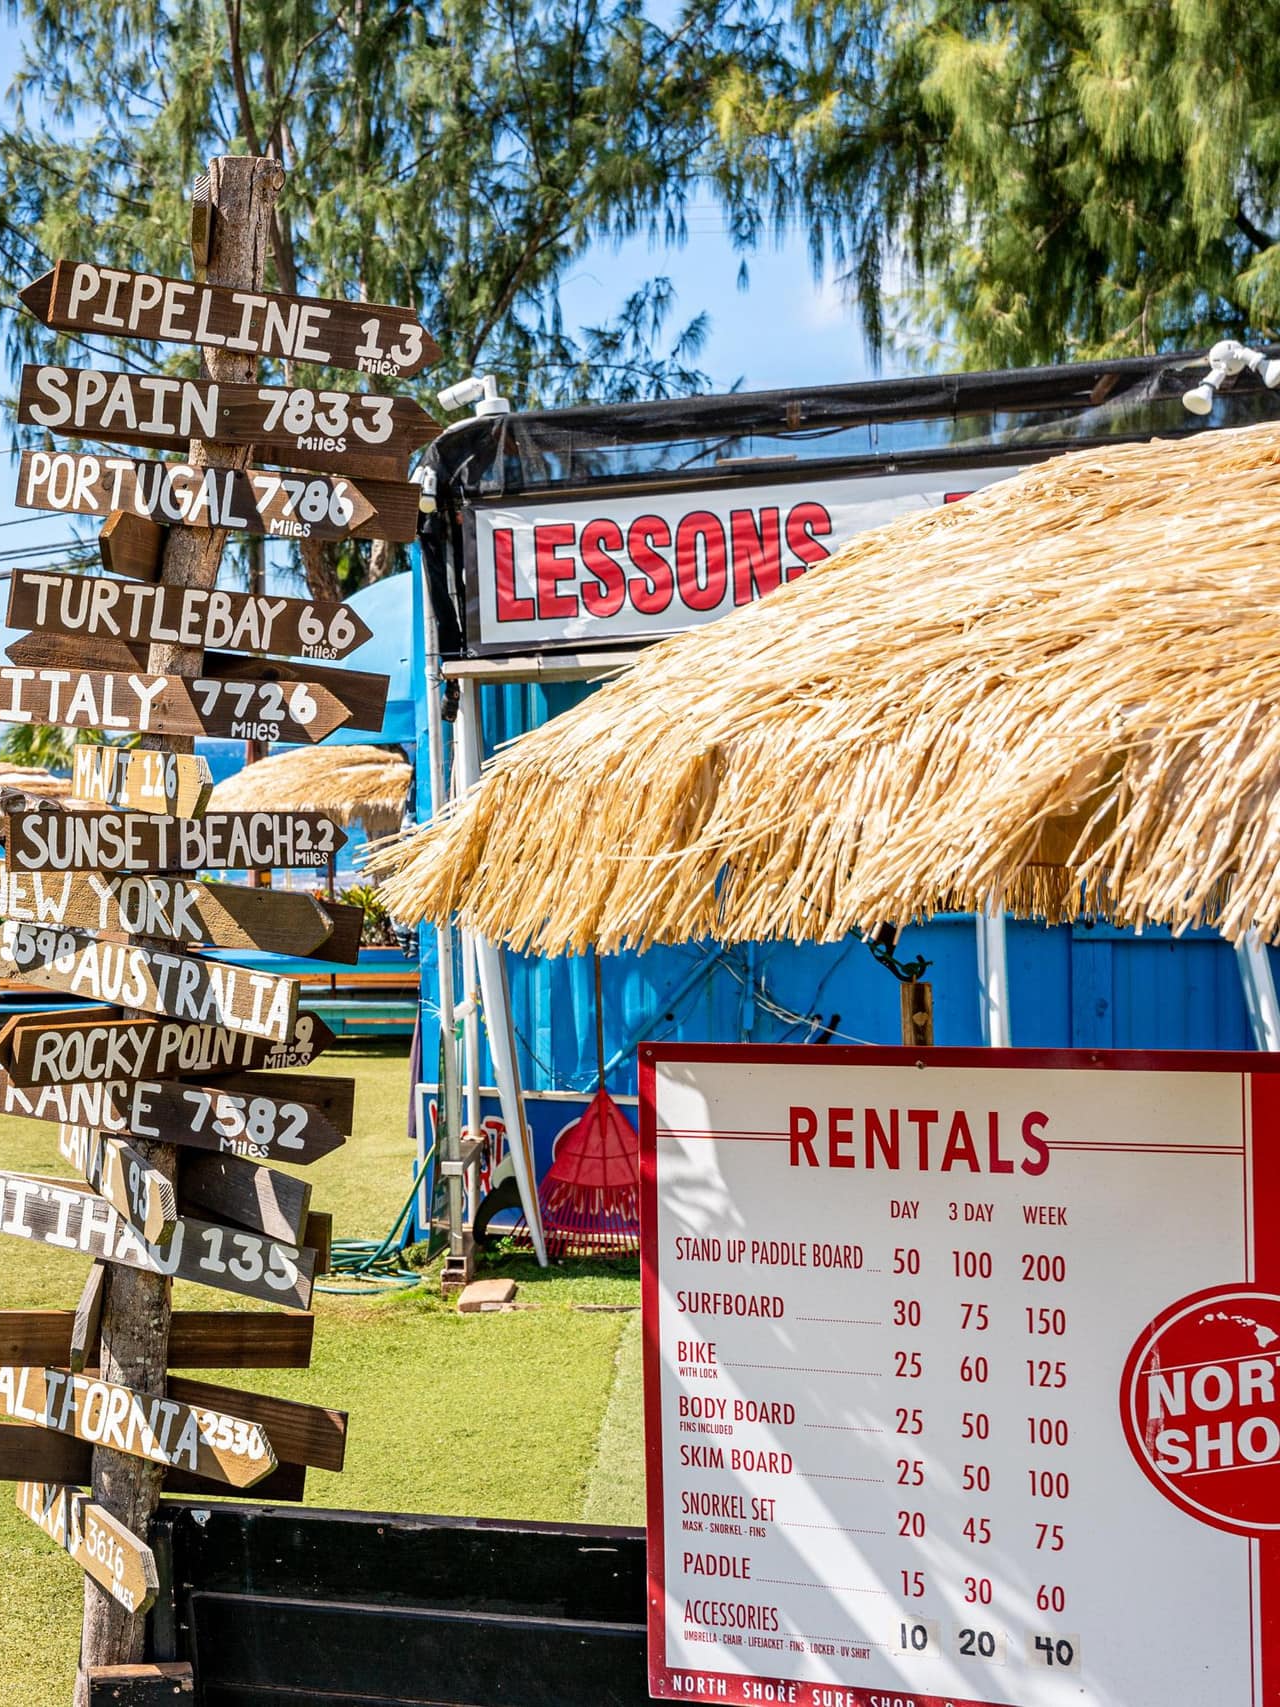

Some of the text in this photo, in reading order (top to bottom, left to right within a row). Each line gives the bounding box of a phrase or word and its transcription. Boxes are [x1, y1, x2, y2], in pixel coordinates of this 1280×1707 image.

[67, 262, 331, 363] PIPELINE
[357, 357, 400, 377] Miles
[28, 366, 394, 444] SPAIN 7833
[296, 435, 346, 453] Miles
[26, 451, 354, 529] PORTUGAL 7786
[269, 517, 311, 538] Miles
[493, 501, 832, 624] LESSONS
[301, 643, 337, 661] Miles
[192, 679, 318, 726] 7726
[231, 721, 280, 742] Miles
[75, 748, 177, 804] MAUI 126
[16, 814, 174, 870] SUNSET
[179, 812, 295, 870] BEACH
[295, 851, 329, 866] Miles
[88, 875, 203, 941] YORK
[70, 940, 293, 1044] AUSTRALIA
[31, 1024, 154, 1082] ROCKY
[183, 1090, 310, 1150] 7582
[790, 1106, 1050, 1176] RENTALS
[219, 1137, 270, 1159] Miles
[890, 1200, 919, 1220] DAY
[948, 1203, 994, 1223] 3 DAY
[1023, 1205, 1068, 1226] WEEK
[199, 1227, 300, 1291] 135
[676, 1237, 1066, 1282] STAND UP PADDLE BOARD 50 100 200
[678, 1291, 1066, 1336] SURFBOARD 30 75 150
[678, 1341, 1067, 1388] BIKE 25 60 125
[679, 1368, 718, 1380] WITH LOCK
[1147, 1356, 1280, 1418] NOR
[679, 1396, 1069, 1446] BODY BOARD 25 50 100
[680, 1422, 733, 1436] FINS INCLUDED
[1154, 1416, 1280, 1475] SHO
[680, 1445, 1070, 1498] SKIM BOARD 25 50 100
[682, 1492, 1064, 1551] SNORKEL SET 20 45 75
[682, 1520, 766, 1538] MASK SNORKEL FINS
[86, 1517, 124, 1581] 3616
[684, 1553, 1065, 1612] PADDLE 15 30 60
[684, 1600, 1074, 1666] ACCESSORIES 10 20 40
[684, 1630, 870, 1660] UMBRELLA CHAIR LIFEJACKET FINS LOCKER UV SHIRT
[672, 1675, 727, 1696] NORTH
[742, 1682, 796, 1703] SHORE
[812, 1689, 854, 1707] SURF
